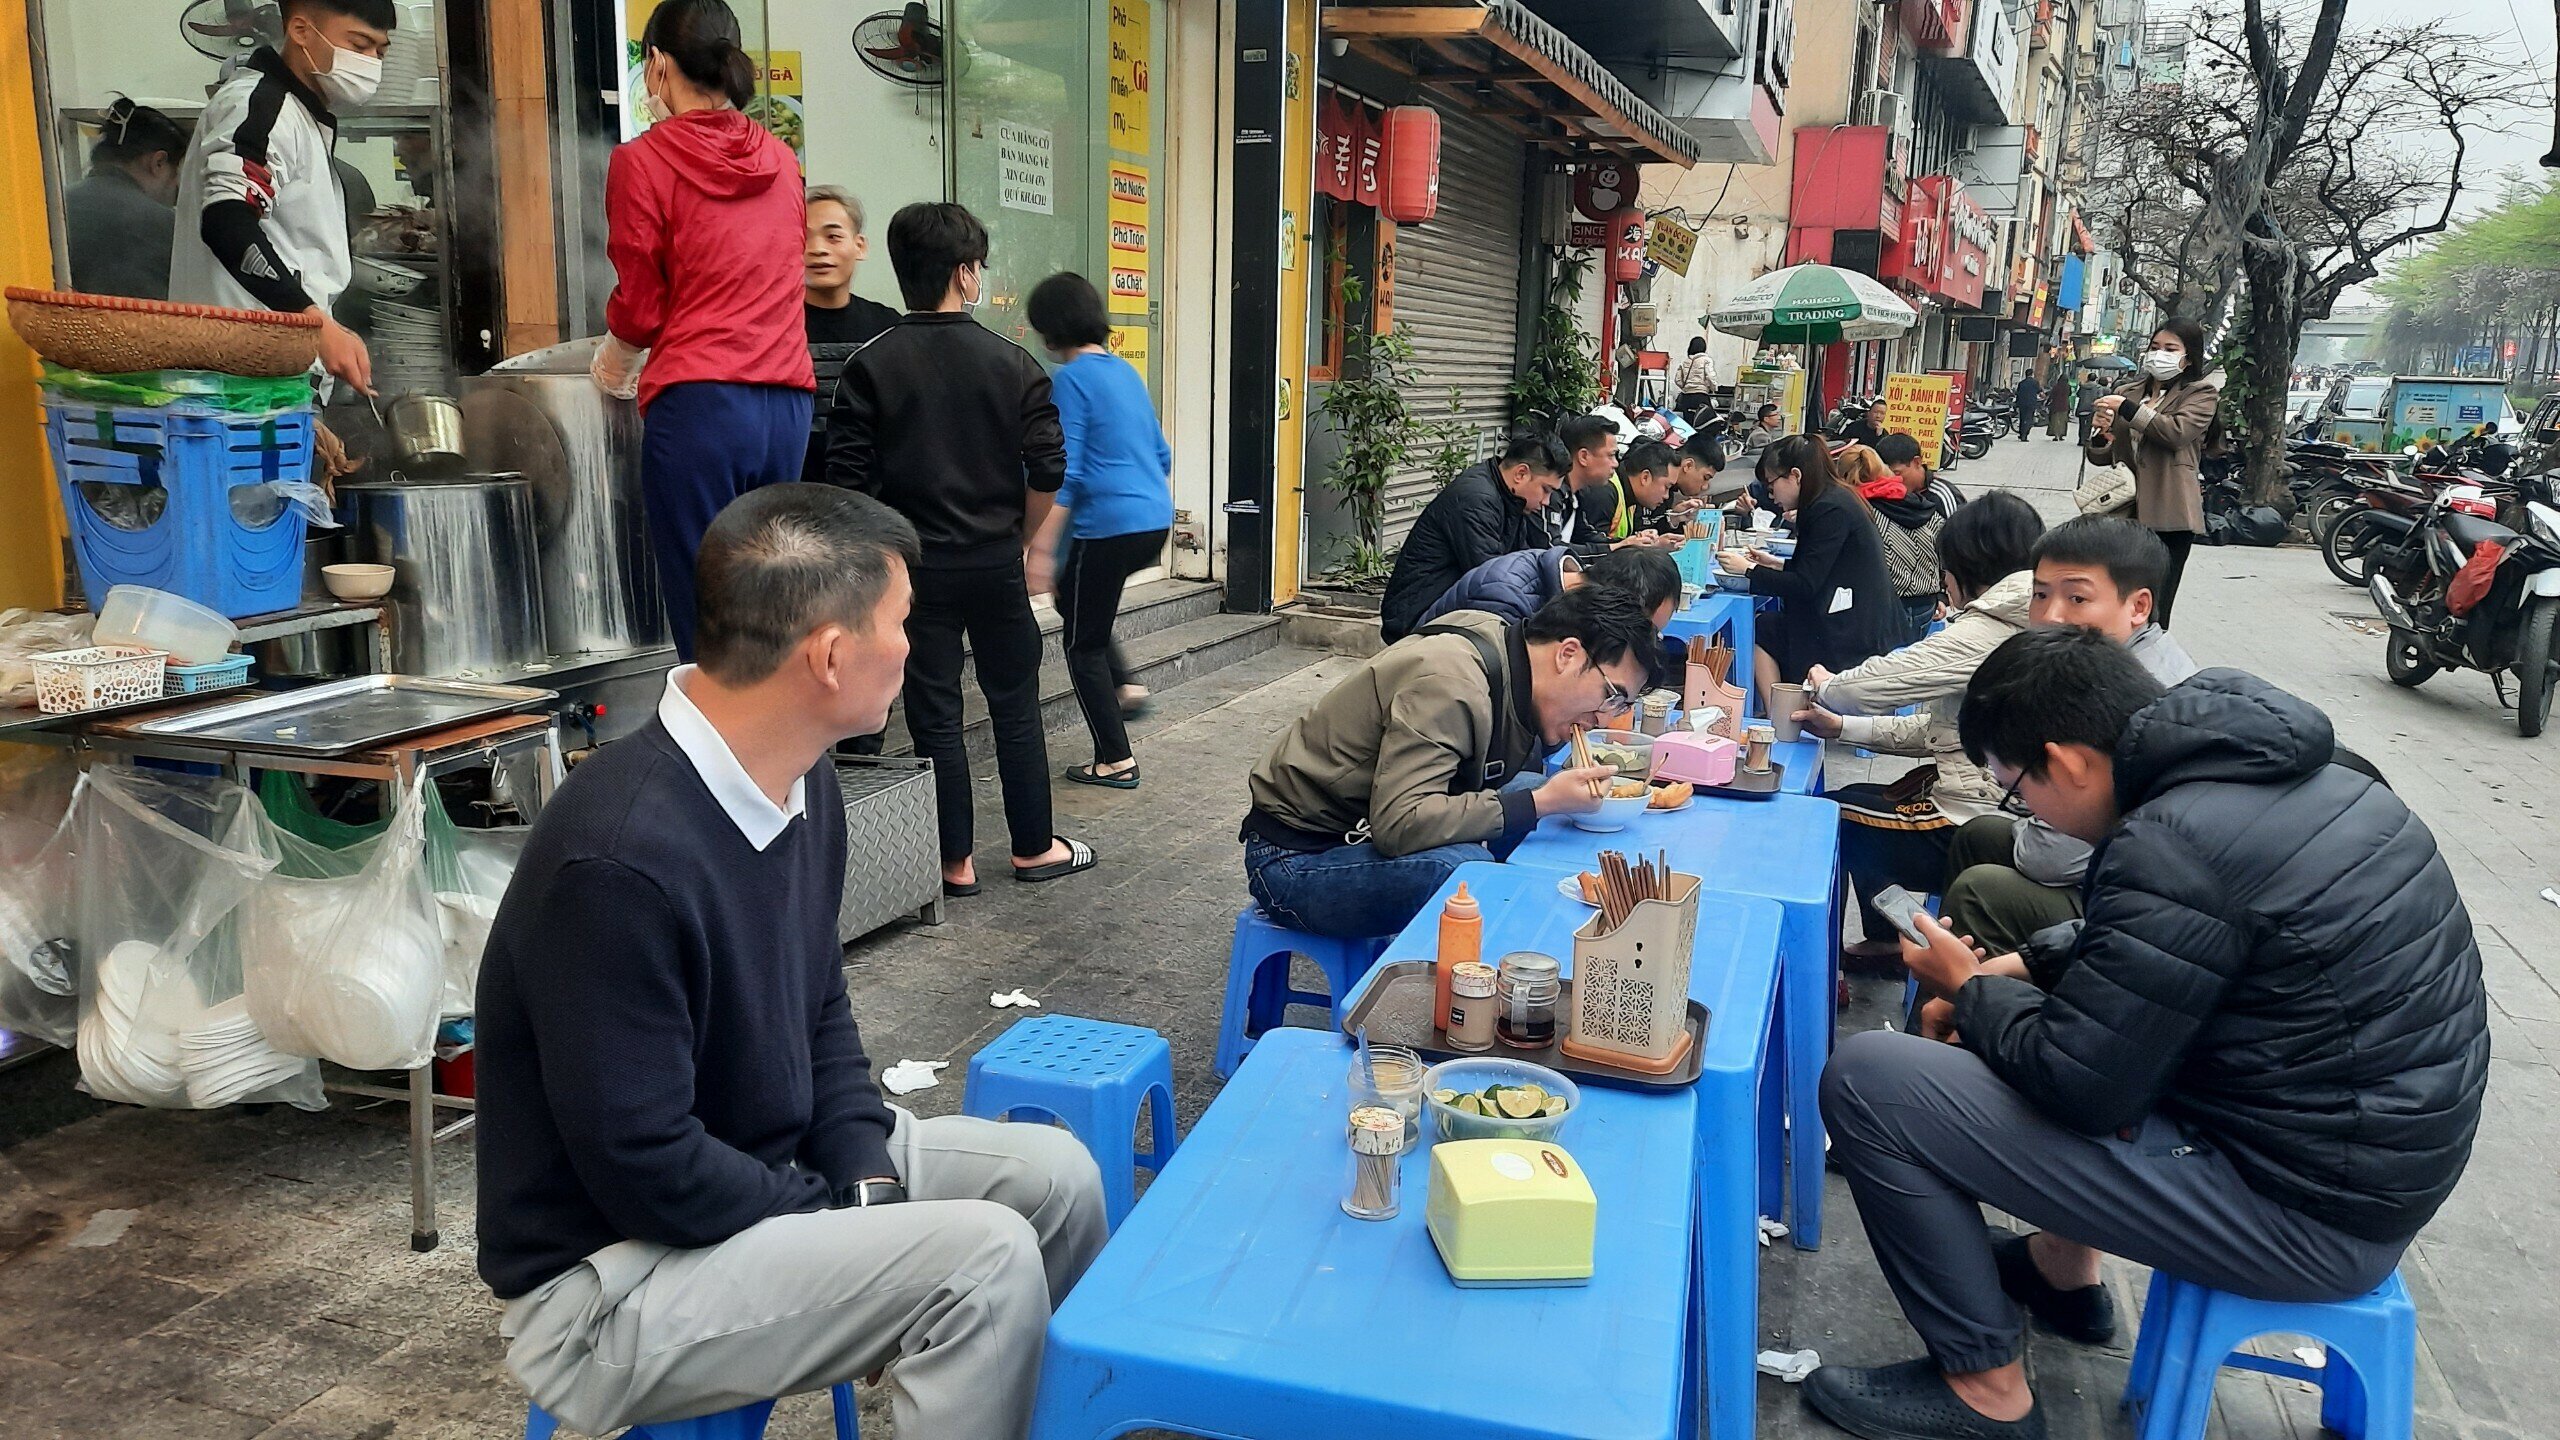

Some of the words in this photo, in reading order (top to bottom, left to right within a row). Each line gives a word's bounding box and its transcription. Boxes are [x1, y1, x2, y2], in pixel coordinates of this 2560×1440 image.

[1113, 6, 1127, 27] Phở
[1113, 41, 1127, 63] Bún
[769, 66, 794, 81] GÀ
[1133, 60, 1148, 93] Gà
[1017, 130, 1038, 147] HÀNG
[1017, 151, 1039, 167] MANG
[1005, 167, 1018, 181] XIN
[1113, 177, 1127, 194] Phở
[1128, 180, 1145, 198] Nước
[1113, 227, 1128, 243] Phở
[1129, 230, 1145, 249] Trộn
[1573, 225, 1606, 236] SINCE
[1115, 273, 1126, 289] Gà
[1787, 308, 1845, 321] TRADING
[1888, 384, 1904, 401] XÔI
[1910, 387, 1934, 404] BÁNH
